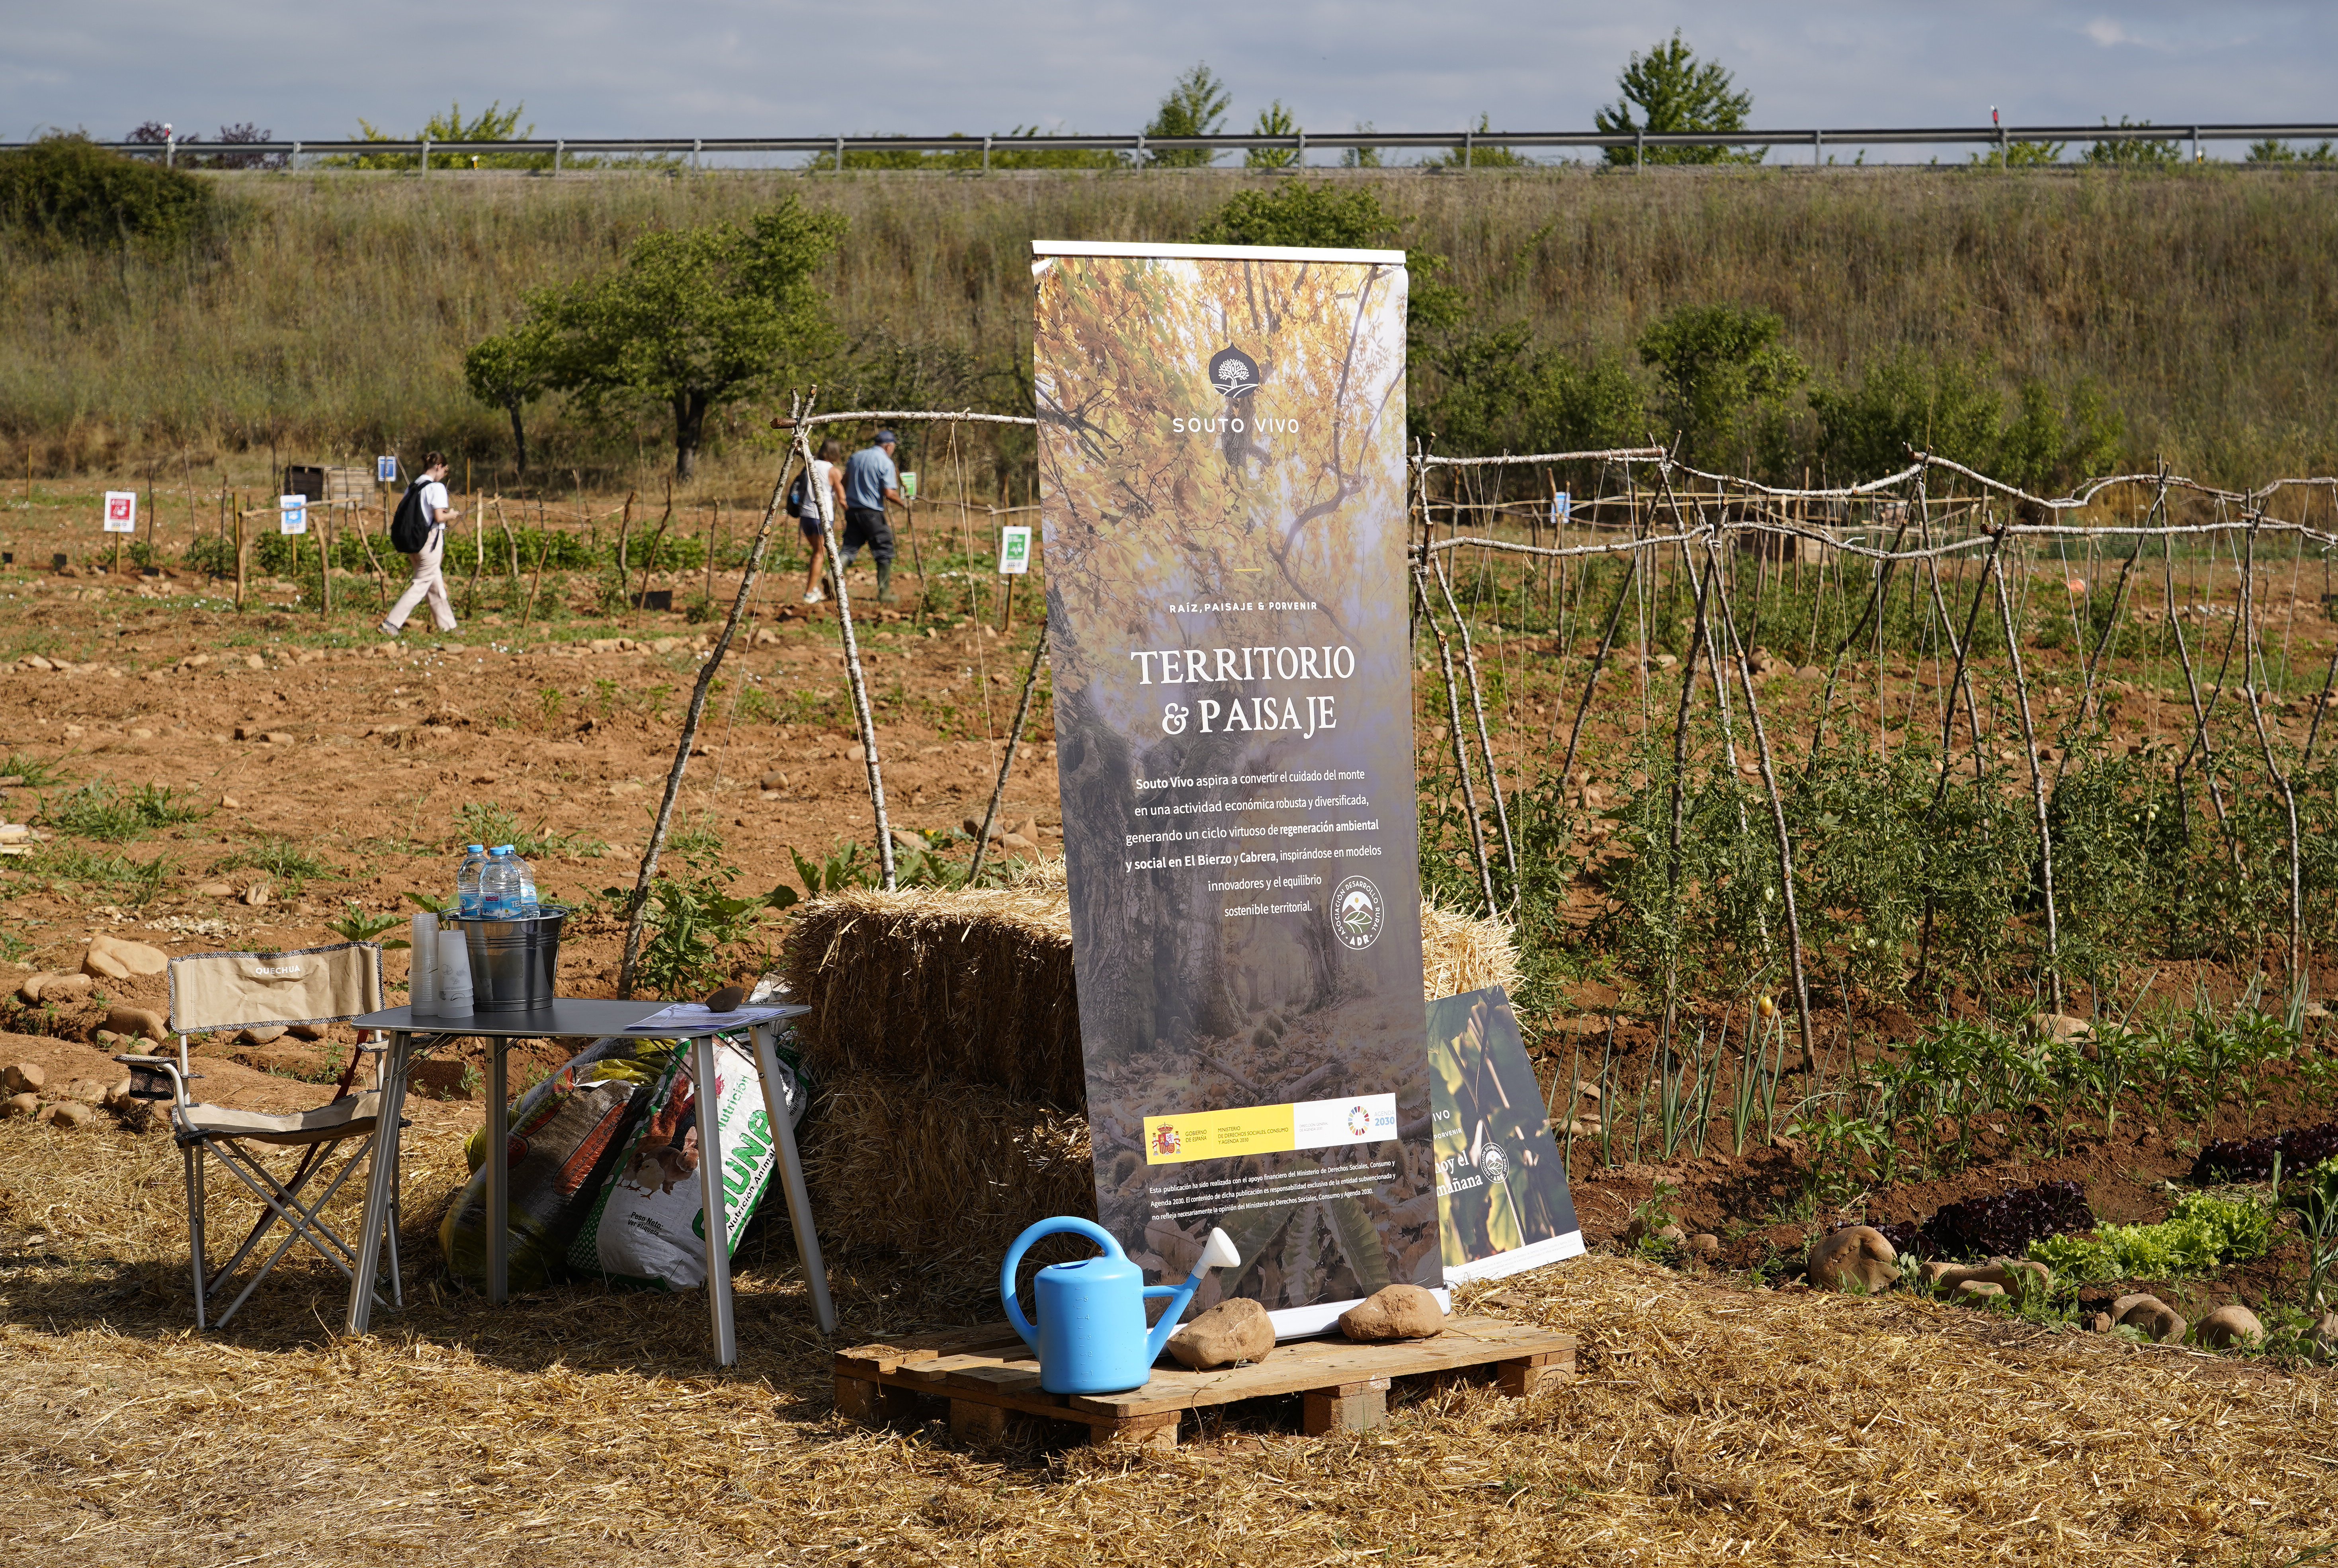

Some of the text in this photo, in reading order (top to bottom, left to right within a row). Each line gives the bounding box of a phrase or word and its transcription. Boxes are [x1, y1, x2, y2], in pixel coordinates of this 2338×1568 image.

[1172, 418, 1299, 434] SOUTO VIVO
[1258, 601, 1265, 611] &
[1269, 601, 1317, 613] PORVENIR
[1131, 645, 1356, 685] TERRITORIO
[1162, 695, 1337, 739] & PAISAJE
[1136, 778, 1170, 790] Souto
[1168, 776, 1194, 788] Vivo
[1195, 774, 1229, 790] aspira
[1240, 771, 1279, 785] convertir
[1279, 771, 1288, 783] el
[1289, 770, 1324, 782] cuidado
[1322, 769, 1337, 781] del
[1338, 769, 1365, 780] monte
[1135, 794, 1369, 817] en una actividad económica robusta y diversificada,
[1125, 818, 1379, 848] generando un ciclo virtuoso de regeneración ambiental
[1125, 844, 1382, 873] y social en El Bierzo y Cabrera, inspirándose en modelos
[1207, 874, 1322, 894] innovadores y el equilibrio
[1224, 900, 1313, 917] sostenible territorial.
[1335, 881, 1380, 935] ASOCIACIÓN DESARROLLO RURAL
[1350, 935, 1369, 946] ADR
[256, 965, 300, 975] QUECHUA
[1375, 1117, 1395, 1126] 2030
[1434, 1128, 1462, 1140] PORVENIR
[1458, 1150, 1469, 1167] el
[1163, 1183, 1191, 1192] publicación
[1248, 1174, 1263, 1183] apoyo
[1264, 1170, 1287, 1181] financiero
[1350, 1163, 1369, 1172] Sociales,
[1437, 1175, 1483, 1197] mañana
[728, 1149, 775, 1231] Nutrición Animal
[1150, 1200, 1172, 1209] Agenda
[1236, 1188, 1263, 1198] publicación
[1270, 1181, 1307, 1194] responsabilidad
[1358, 1173, 1391, 1183] subvencionada
[1178, 1209, 1213, 1218] necesariamente
[1219, 1205, 1237, 1213] opinión
[1246, 1200, 1268, 1209] Ministerio
[1276, 1197, 1297, 1205] Derechos
[1298, 1194, 1318, 1203] Sociales,
[1344, 1190, 1361, 1198] Agenda
[631, 1212, 663, 1230] Peso Neto:
[637, 1223, 659, 1235] etiqueta
